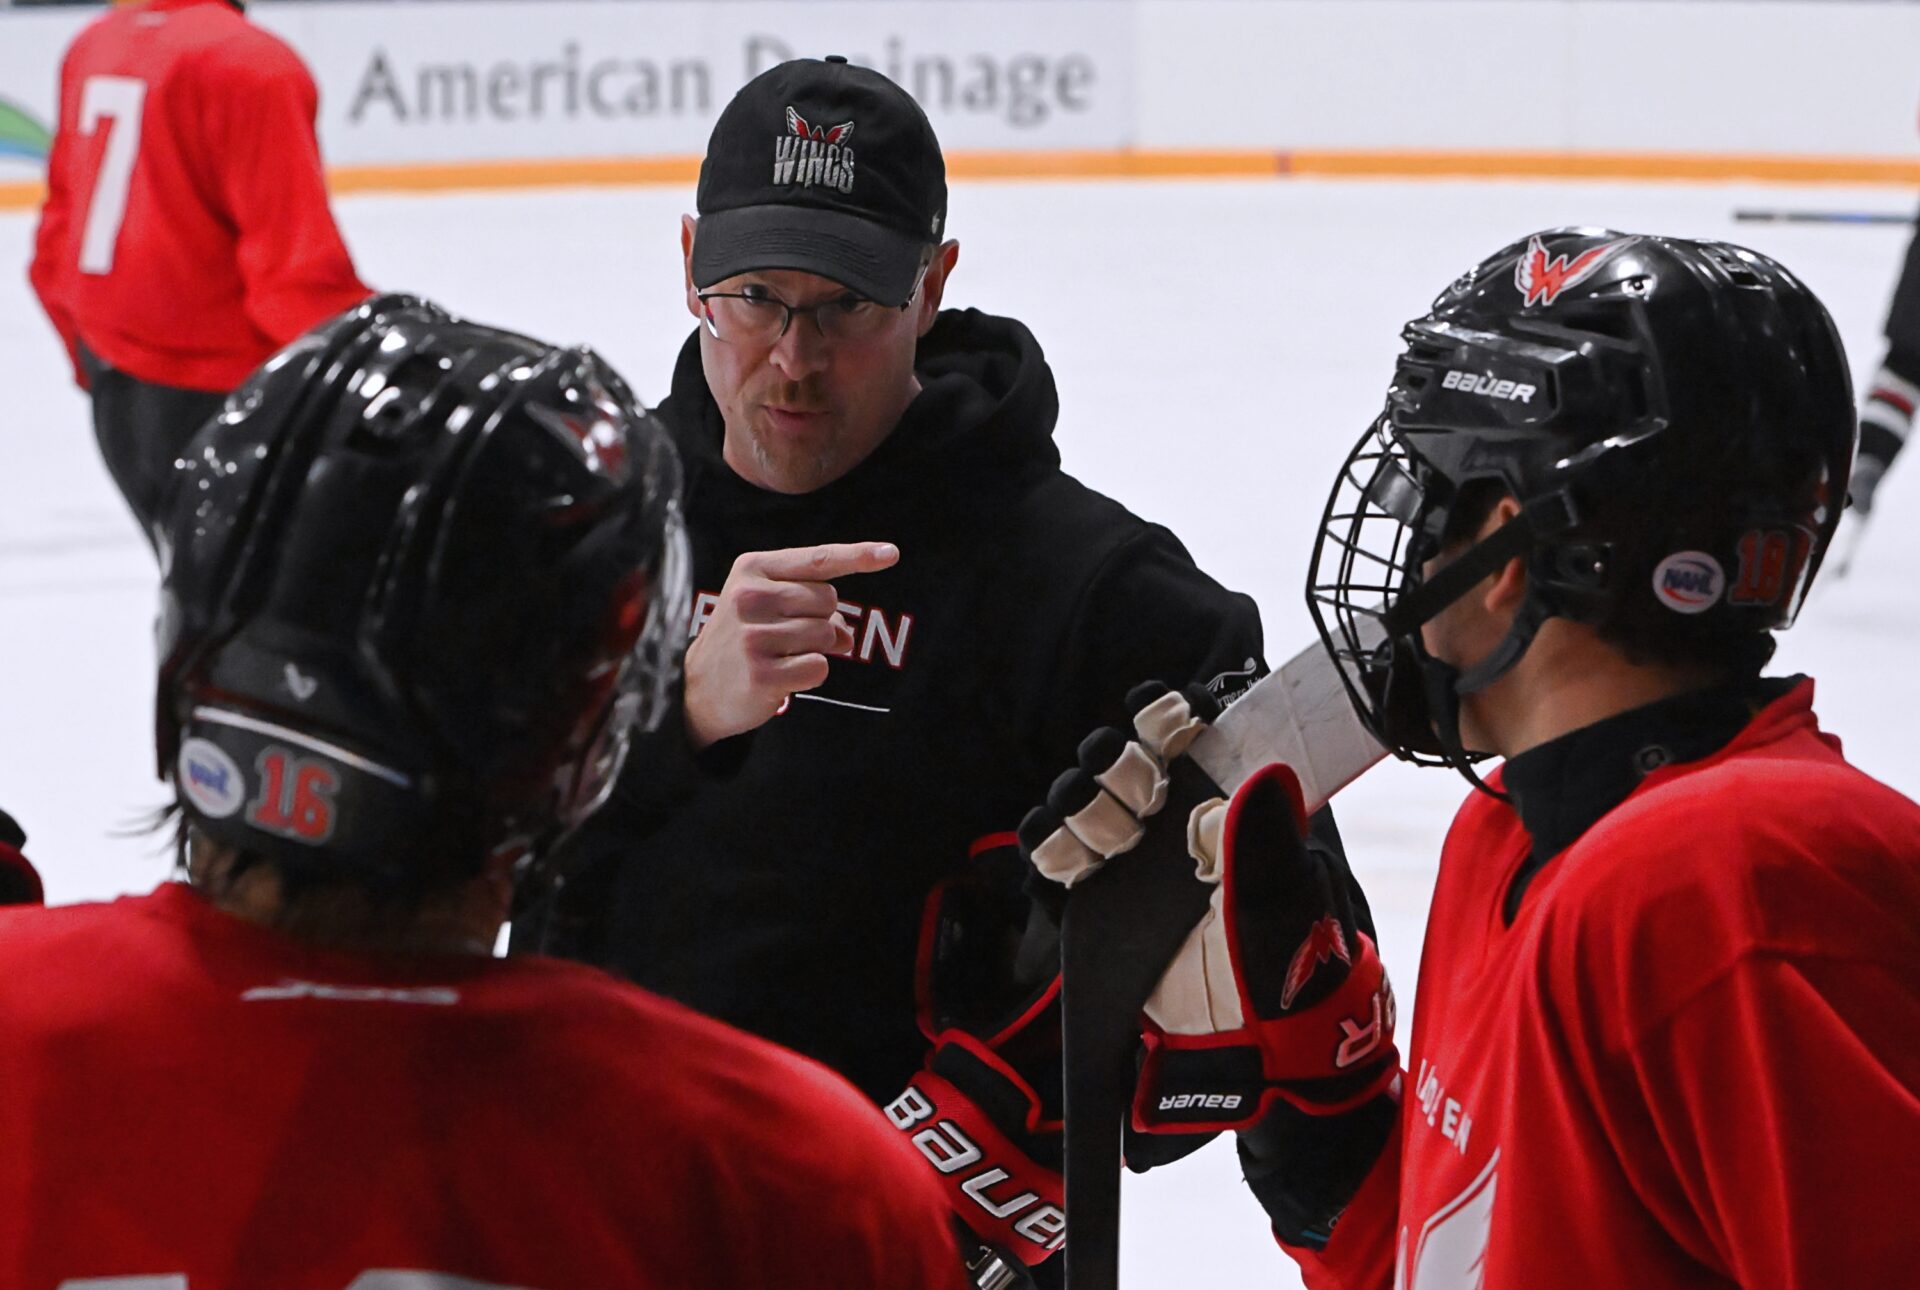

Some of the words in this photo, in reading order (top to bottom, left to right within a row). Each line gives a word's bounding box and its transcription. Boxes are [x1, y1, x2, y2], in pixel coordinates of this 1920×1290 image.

[348, 42, 711, 121] American
[745, 36, 1093, 126] Dinage
[79, 76, 146, 275] 7
[773, 135, 855, 194] WINGS
[246, 745, 341, 846] 16
